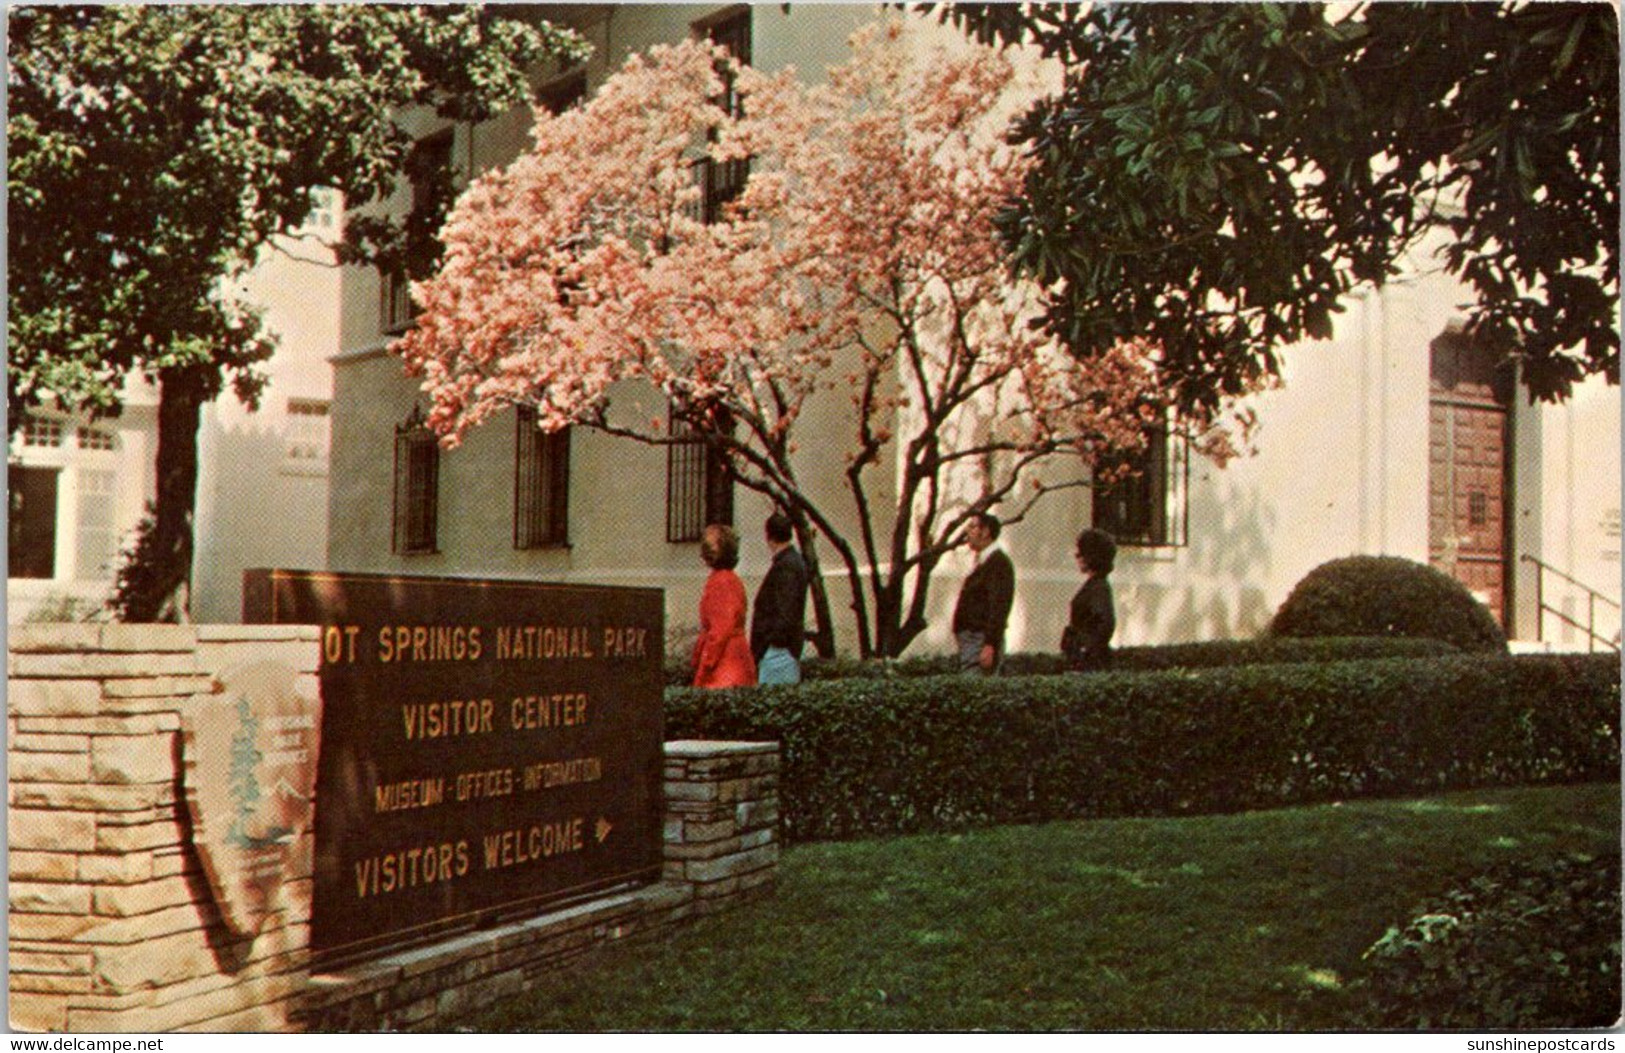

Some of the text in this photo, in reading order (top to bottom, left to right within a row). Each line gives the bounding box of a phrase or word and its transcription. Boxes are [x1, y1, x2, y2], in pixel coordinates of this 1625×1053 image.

[324, 624, 647, 663] OT SPRINGS NATIONAL PARK
[403, 693, 588, 740] VISITOR CENTER
[375, 779, 443, 813] MUSEUM
[457, 771, 513, 801] OFFICES
[356, 819, 583, 897] VISITORS WELCOME
